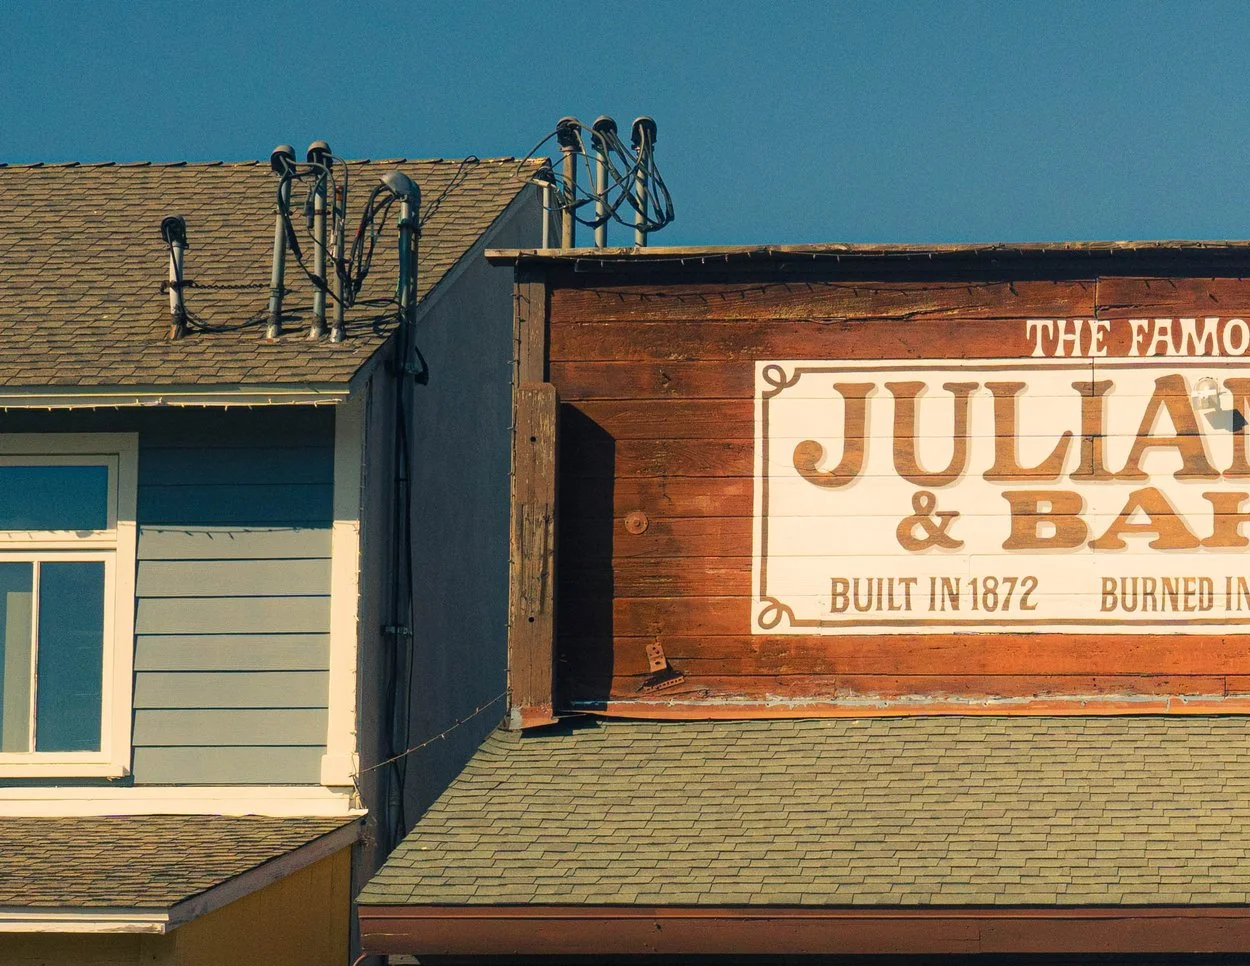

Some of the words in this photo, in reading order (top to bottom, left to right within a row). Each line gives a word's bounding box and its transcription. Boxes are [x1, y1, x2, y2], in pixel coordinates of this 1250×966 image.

[1026, 319, 1112, 357] THE
[895, 490, 966, 552] &
[829, 576, 918, 613] BUILT
[927, 576, 961, 612] IN
[969, 575, 1039, 613] 1872
[1100, 576, 1214, 613] BURNED
